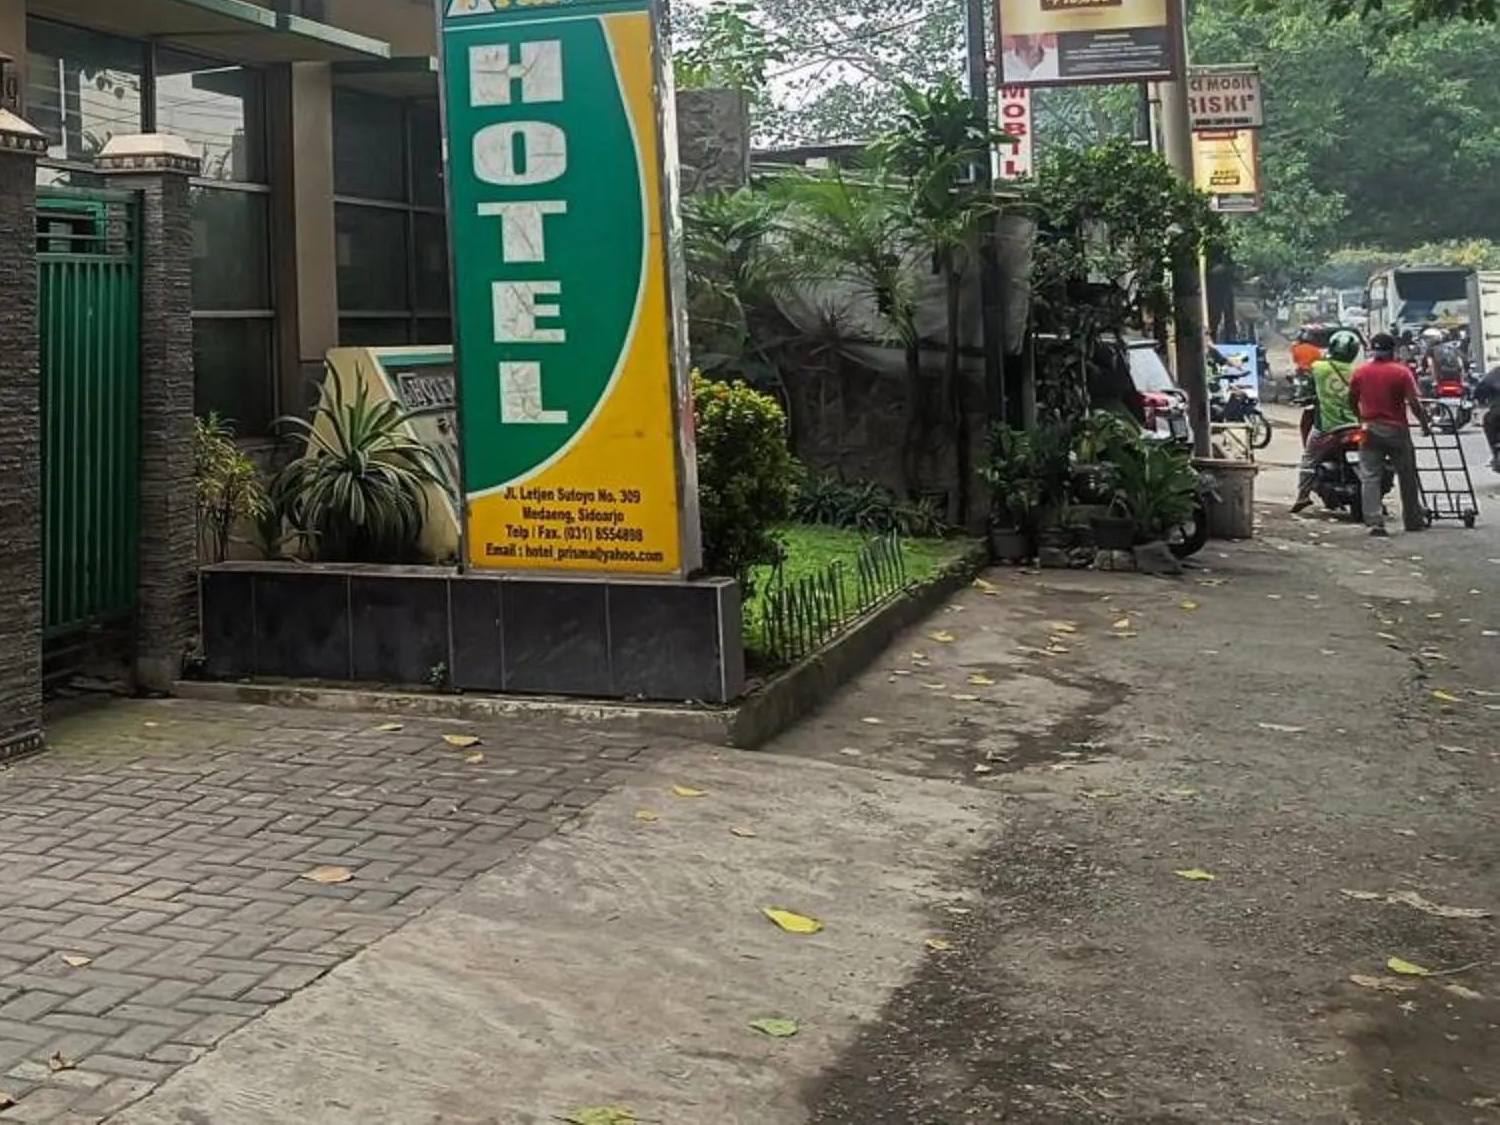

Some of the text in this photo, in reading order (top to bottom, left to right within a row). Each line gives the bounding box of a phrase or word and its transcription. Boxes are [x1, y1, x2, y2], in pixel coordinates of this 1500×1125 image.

[468, 39, 569, 424] HOTEL
[520, 487, 555, 502] Letjen
[557, 488, 595, 505] Sutoyo
[578, 507, 625, 525] Sidoarjo
[485, 542, 518, 557] Email
